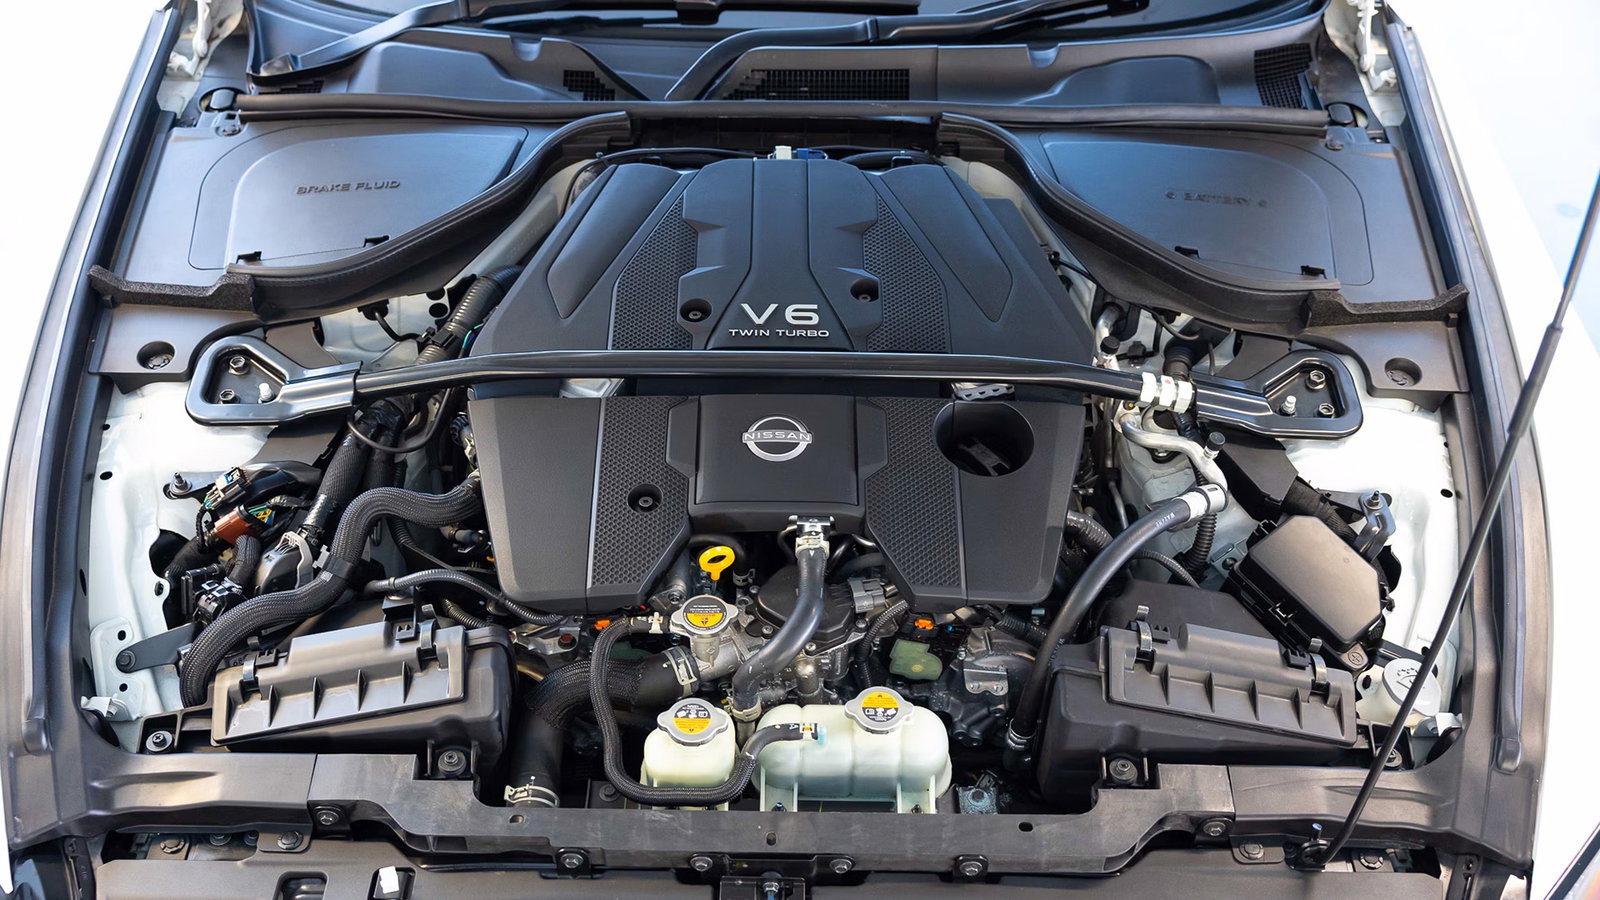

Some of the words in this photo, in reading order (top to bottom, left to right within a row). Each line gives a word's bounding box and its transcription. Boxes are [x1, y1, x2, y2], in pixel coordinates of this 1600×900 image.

[296, 183, 351, 195] BRAKE
[355, 180, 401, 191] FLUID
[740, 303, 820, 325] V6
[728, 329, 770, 337] TWIN
[776, 329, 830, 337] TURBO
[744, 431, 810, 441] NISSAN
